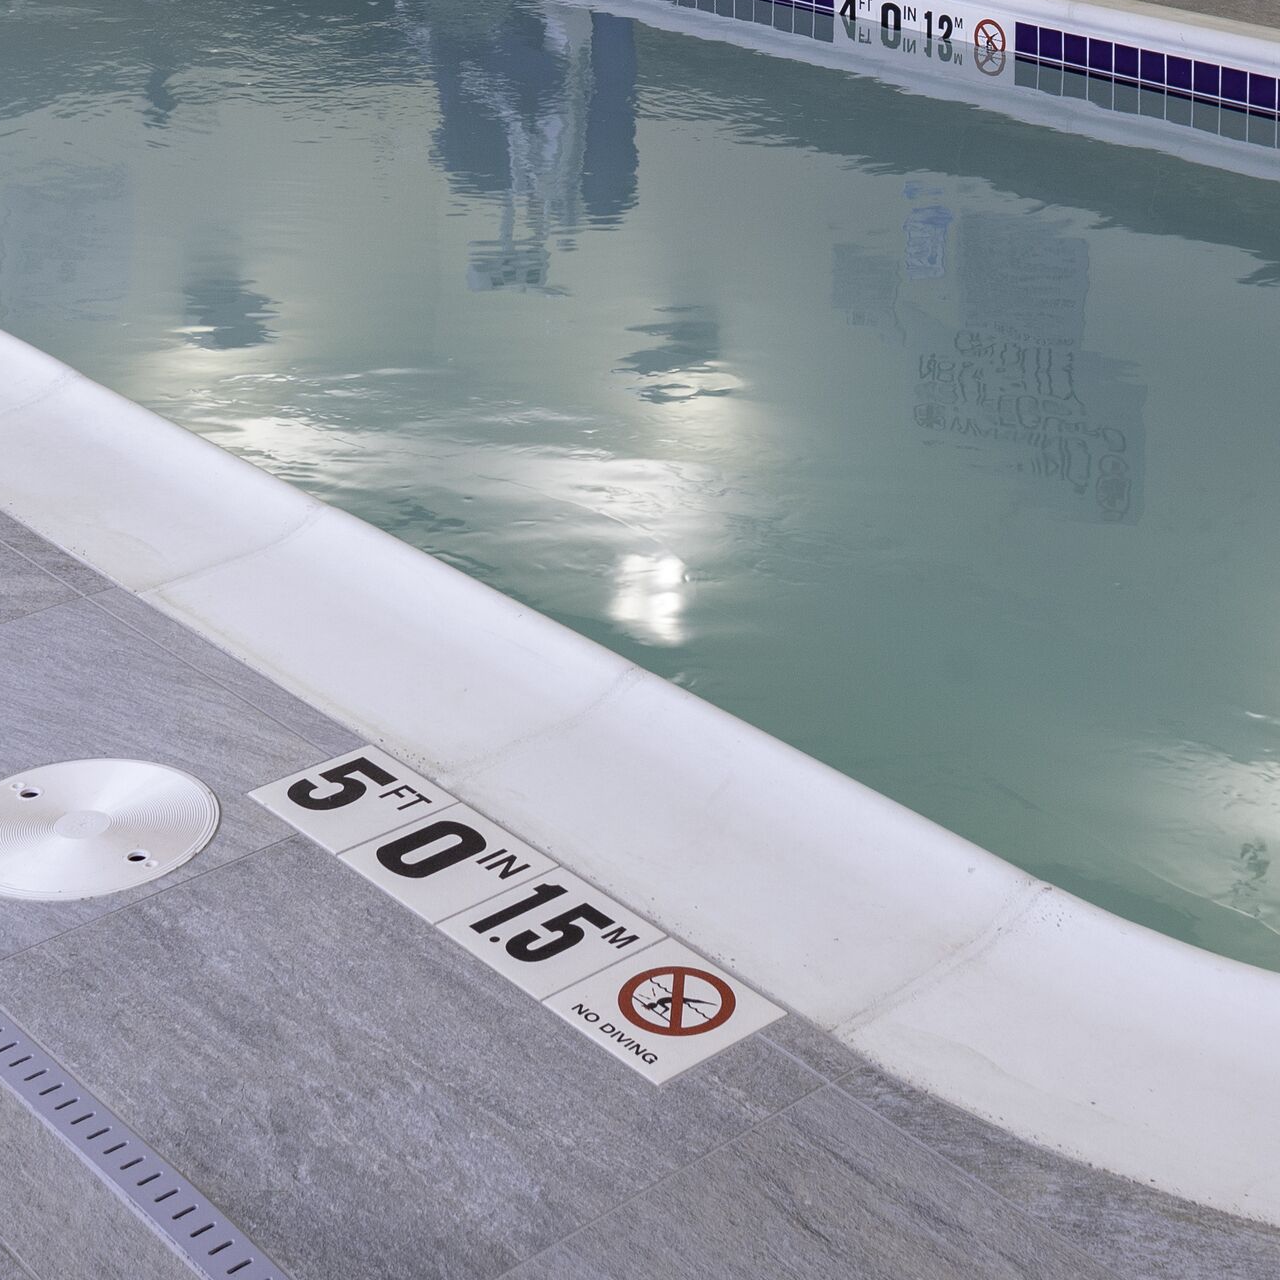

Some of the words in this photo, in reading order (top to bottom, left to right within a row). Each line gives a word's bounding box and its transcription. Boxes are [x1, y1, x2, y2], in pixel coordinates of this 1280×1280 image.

[881, 2, 901, 31] 0
[904, 5, 916, 22] IN
[955, 16, 963, 29] M
[287, 757, 399, 811] 5
[378, 784, 432, 812] FT
[376, 820, 487, 879] 0
[476, 849, 531, 881] IN
[469, 883, 615, 963] 1.5
[601, 927, 640, 950] M
[572, 1003, 600, 1023] NO
[599, 1022, 658, 1066] DIVING
